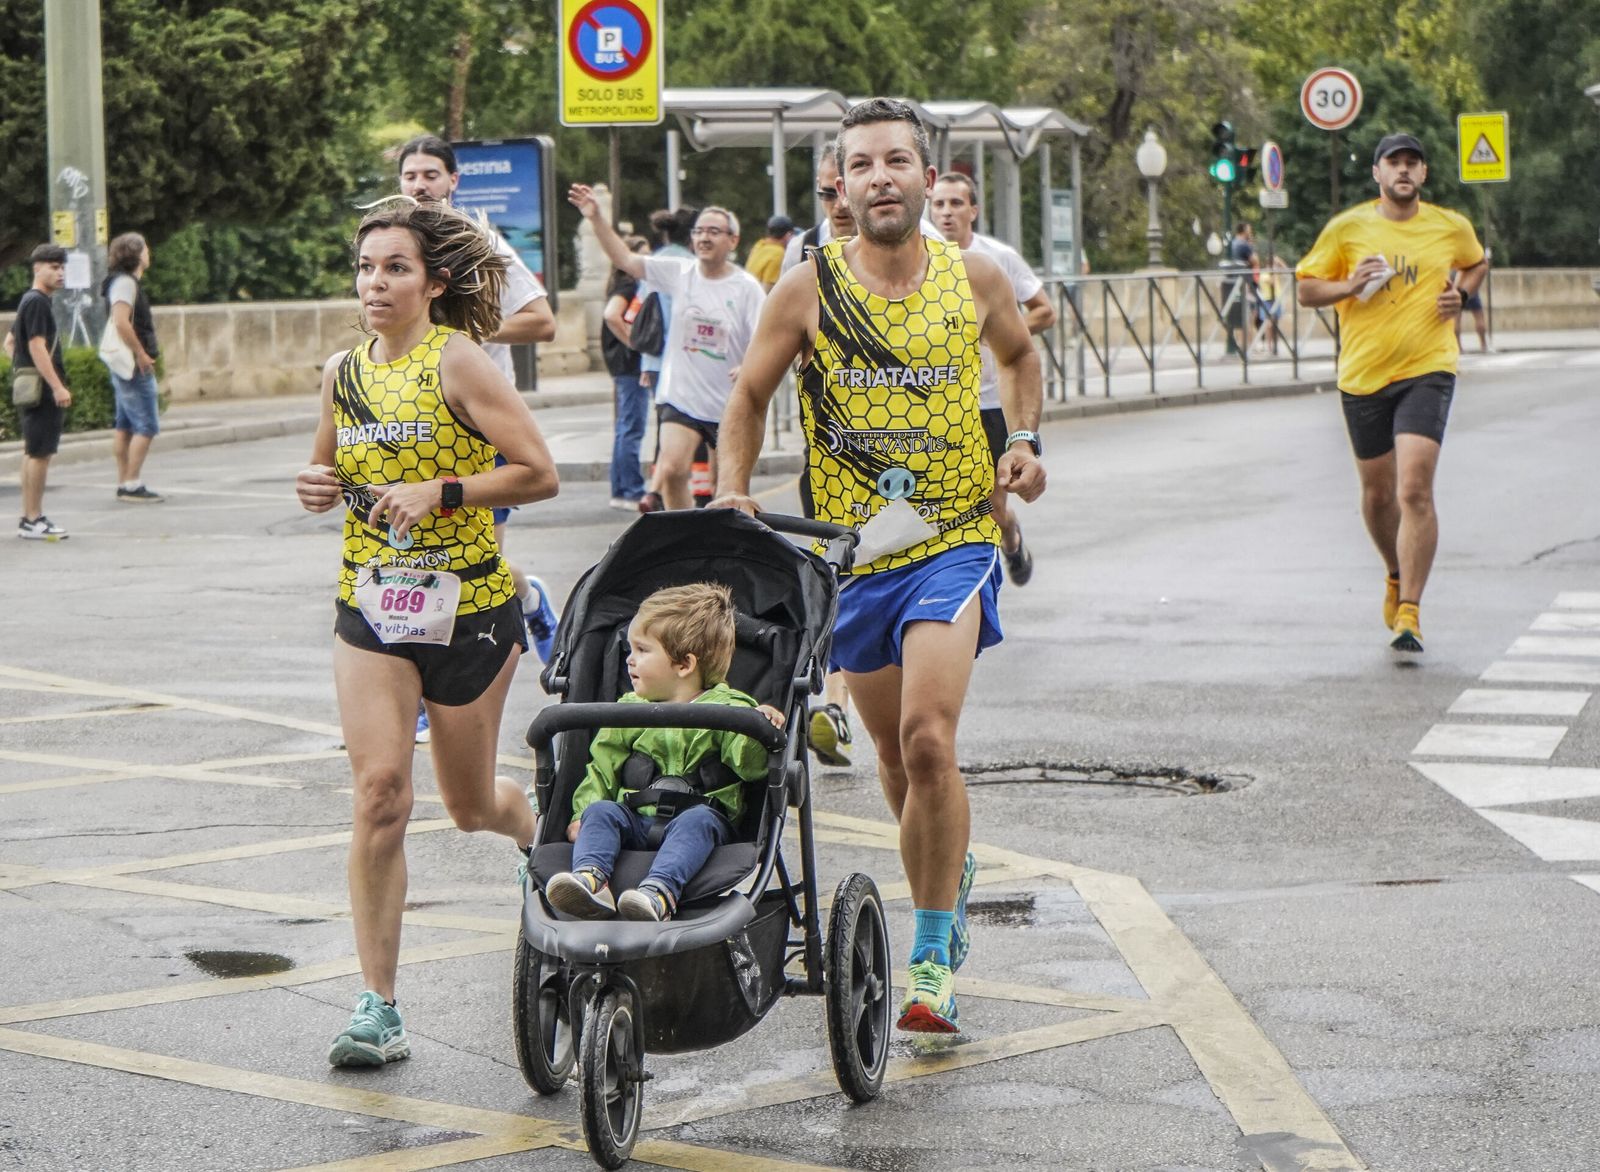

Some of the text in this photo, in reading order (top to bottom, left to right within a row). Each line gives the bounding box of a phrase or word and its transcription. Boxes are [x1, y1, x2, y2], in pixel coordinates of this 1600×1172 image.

[604, 32, 615, 47] P
[595, 52, 625, 64] BUS
[577, 87, 644, 102] SOLO BUS
[1316, 90, 1346, 107] 30
[569, 105, 655, 116] METROPOLITANO
[697, 324, 714, 336] 126
[833, 365, 960, 389] TRIATARFE
[336, 421, 433, 448] TRIATARFE
[844, 435, 947, 454] NEVADIS
[851, 503, 870, 518] TU
[380, 588, 426, 614] 689
[385, 623, 426, 636] vithas
